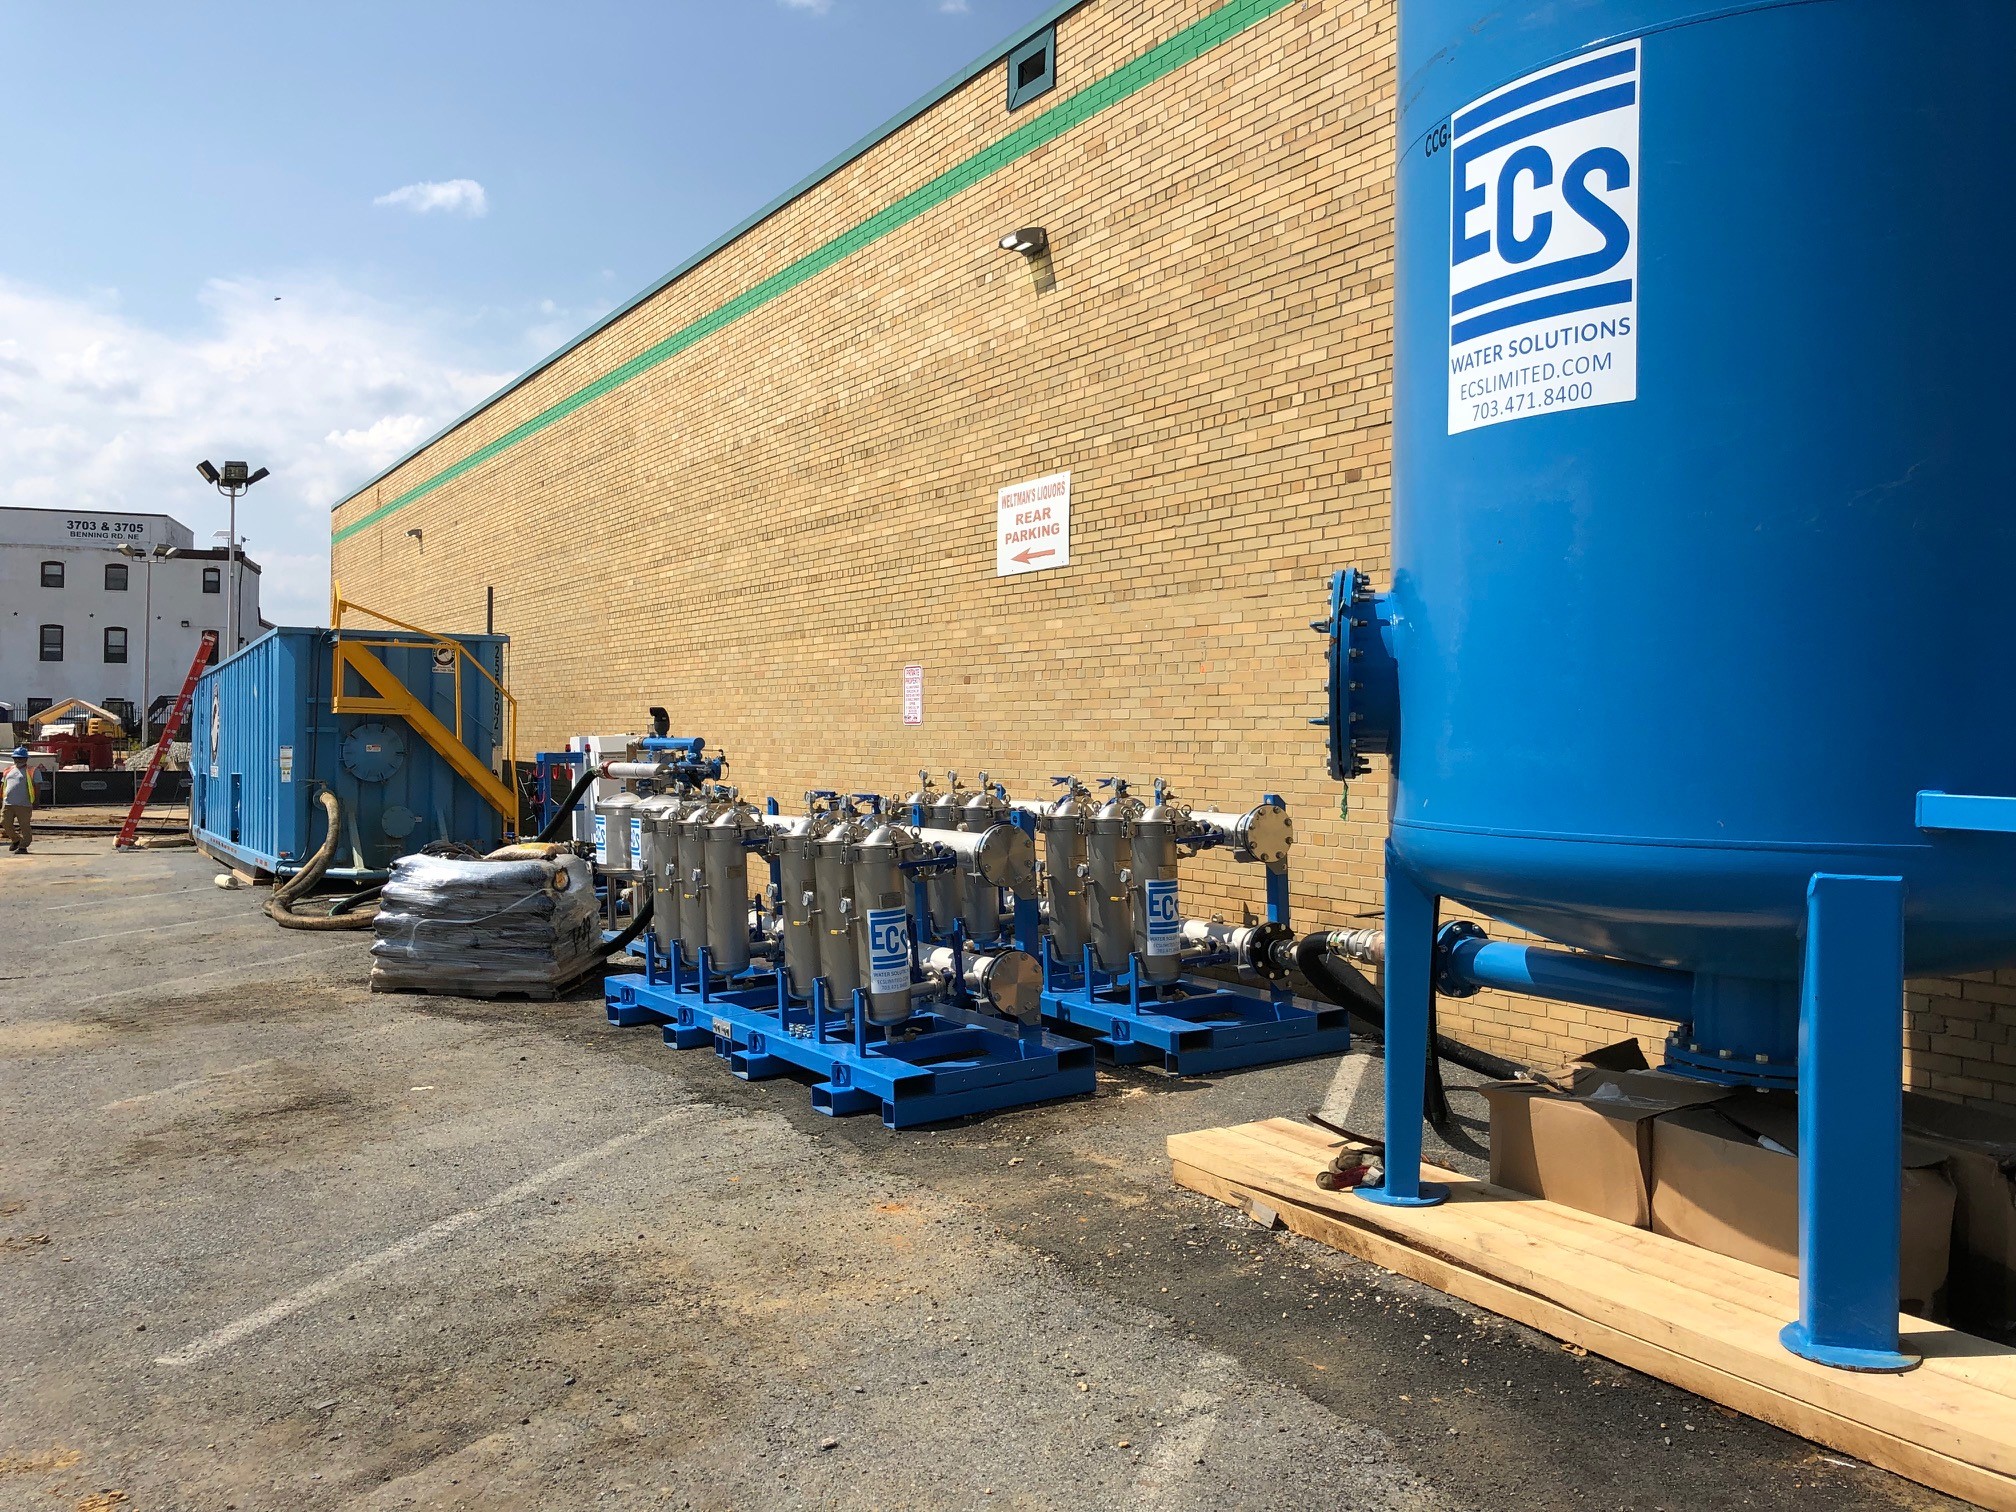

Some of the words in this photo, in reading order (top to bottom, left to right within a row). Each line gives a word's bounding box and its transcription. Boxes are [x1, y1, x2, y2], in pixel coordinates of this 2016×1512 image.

[1452, 143, 1631, 280] ECS
[1450, 344, 1503, 375] WATER
[1508, 317, 1631, 359] SOLUTIONS
[1460, 351, 1612, 401] ECSLIMITED.COM
[1472, 381, 1593, 423] 703.471.8400
[1001, 488, 1036, 510] WELTMAN'S
[1037, 480, 1066, 500] LIQUORS
[66, 520, 97, 531] 3703
[101, 521, 110, 531] &
[114, 522, 144, 533] 3705
[1015, 506, 1052, 526] REAR
[69, 530, 109, 539] BENNING
[1005, 522, 1060, 545] PARKING
